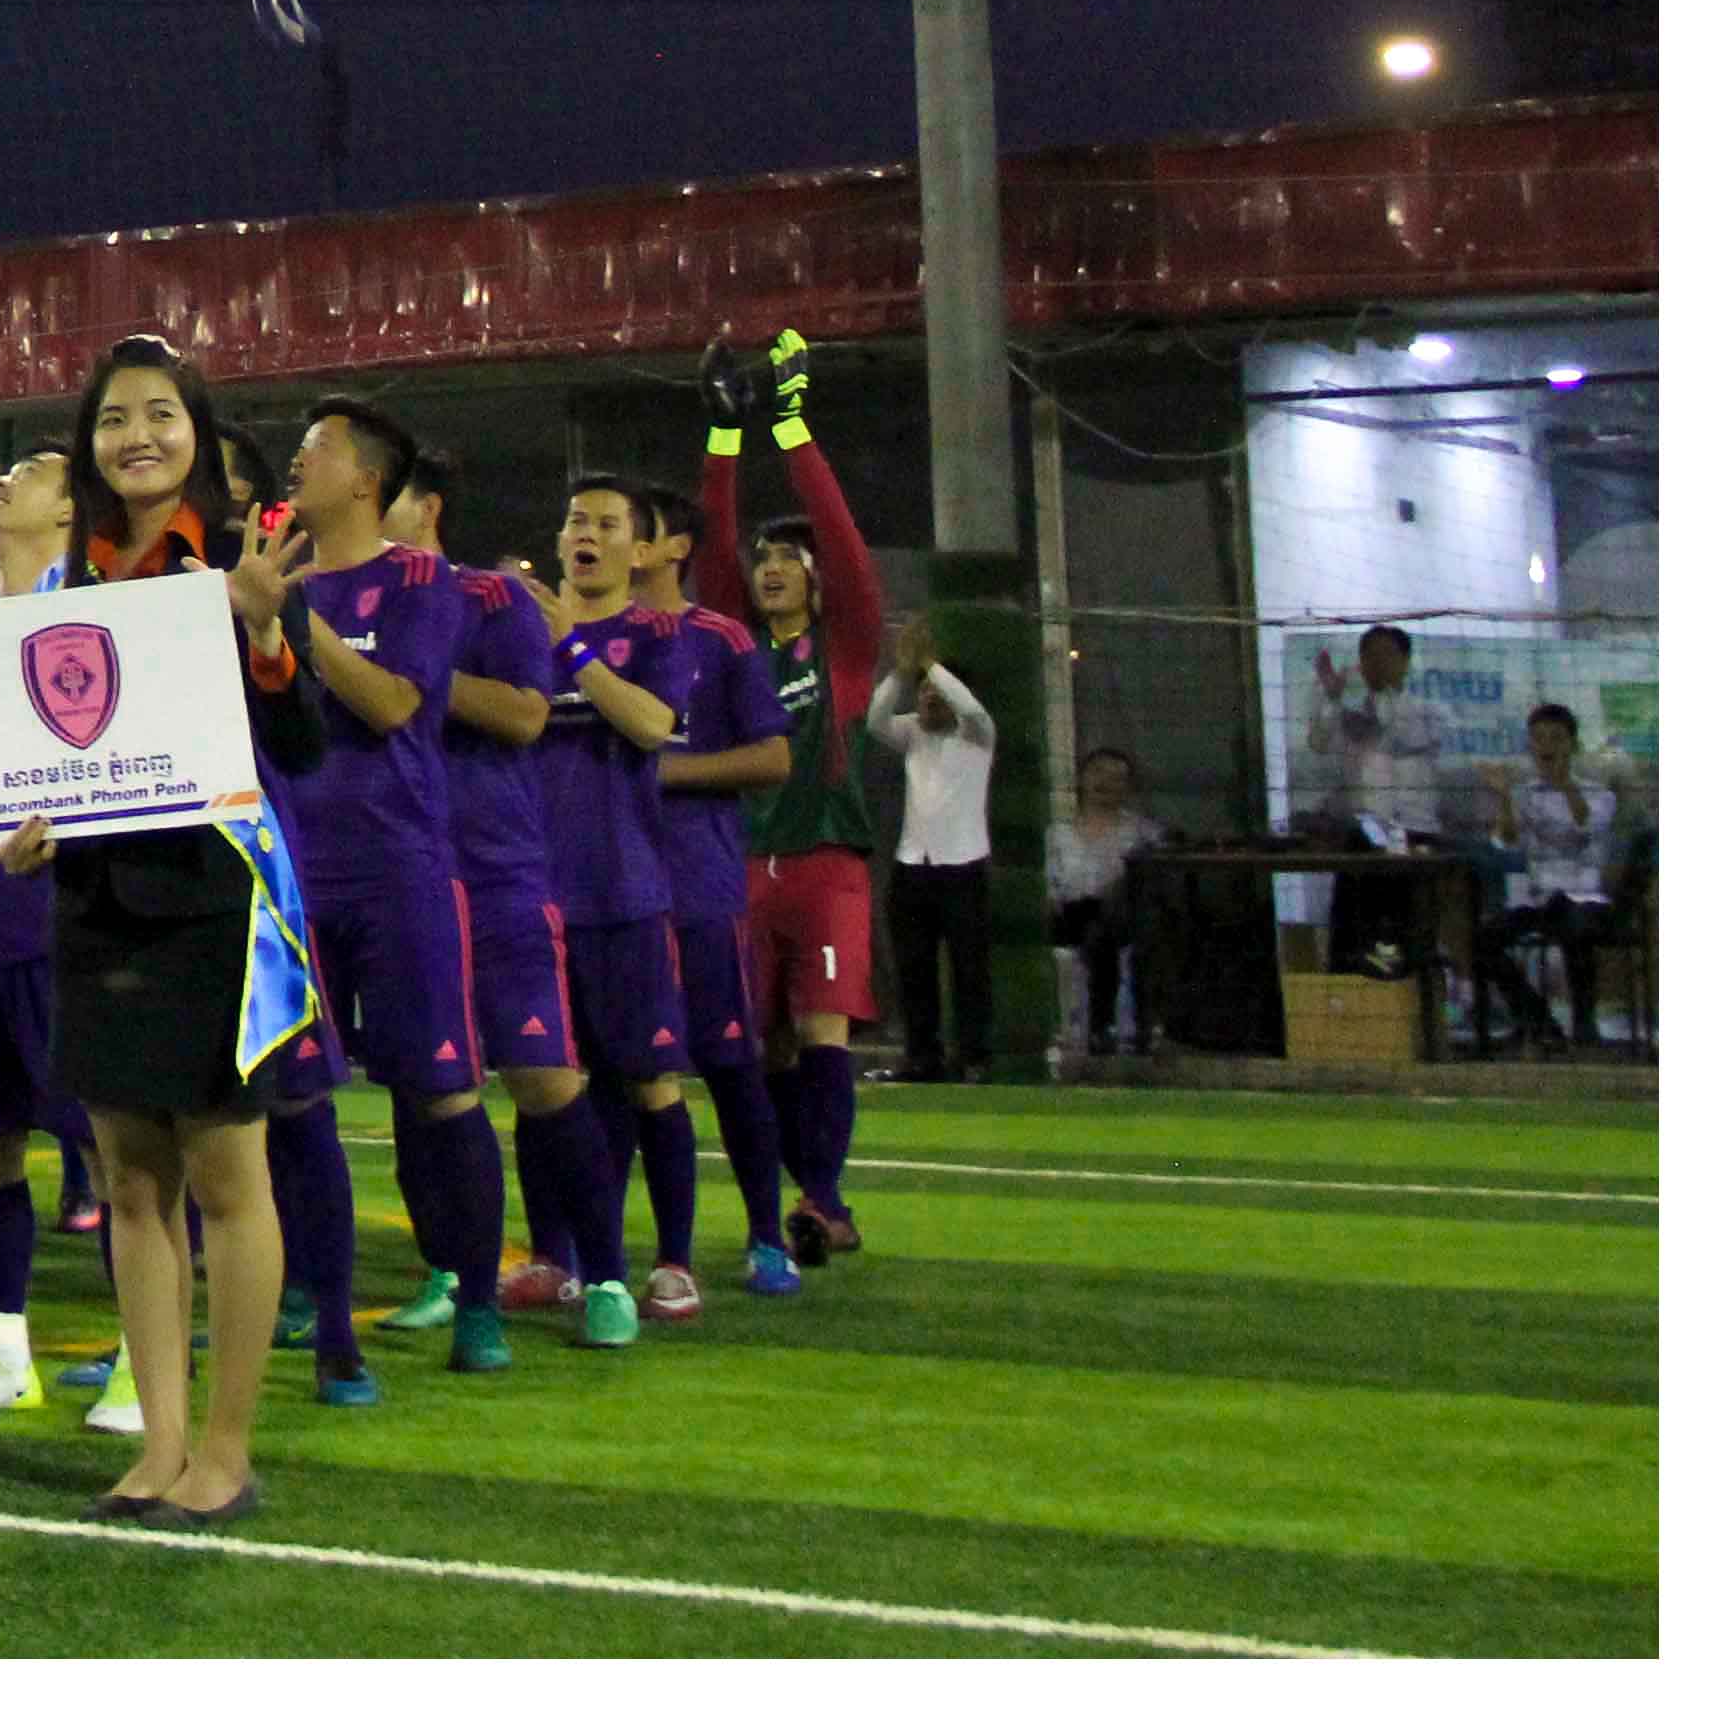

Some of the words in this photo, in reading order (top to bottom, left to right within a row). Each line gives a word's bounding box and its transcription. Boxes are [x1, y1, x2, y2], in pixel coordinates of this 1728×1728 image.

[91, 784, 148, 805] Phnom
[155, 780, 198, 797] Penh
[821, 944, 836, 981] 1
